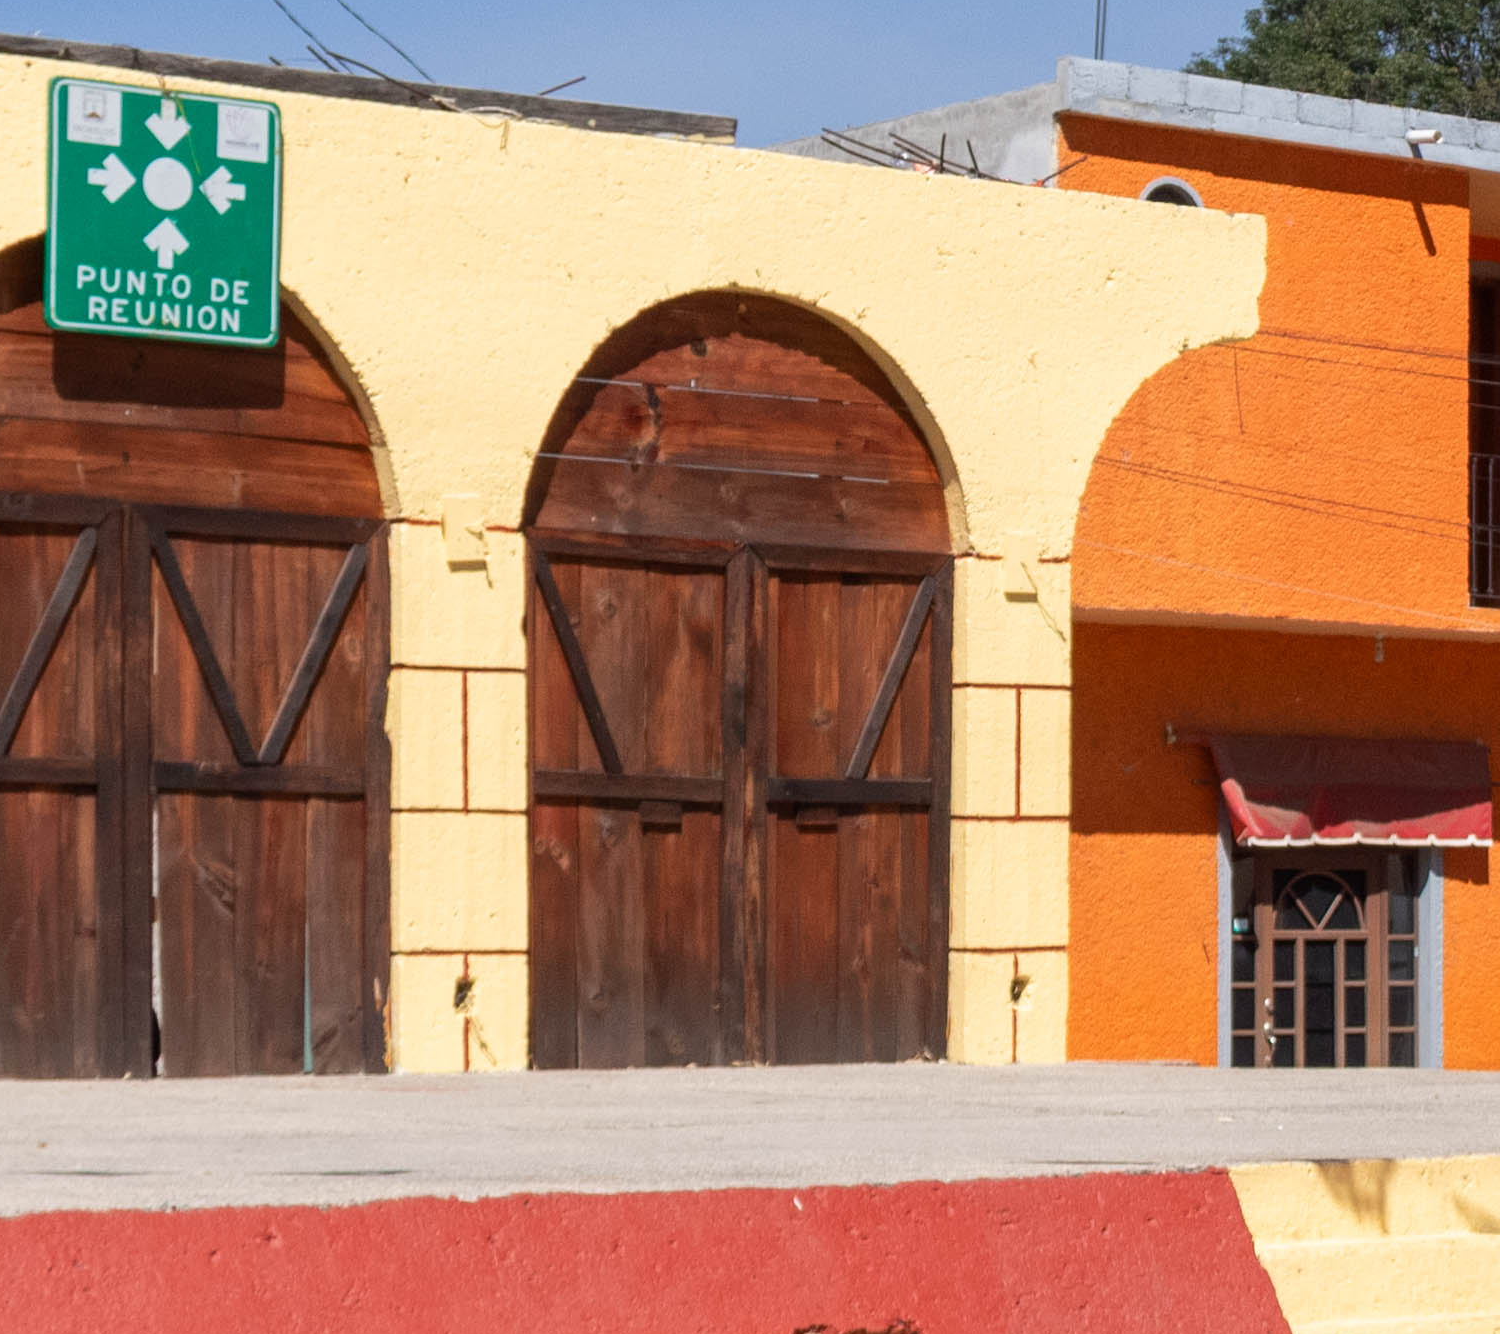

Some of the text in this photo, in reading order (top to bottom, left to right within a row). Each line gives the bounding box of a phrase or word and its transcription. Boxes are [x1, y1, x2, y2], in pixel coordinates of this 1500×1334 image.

[76, 265, 250, 305] PUNTO DE
[89, 296, 240, 333] REUNION
